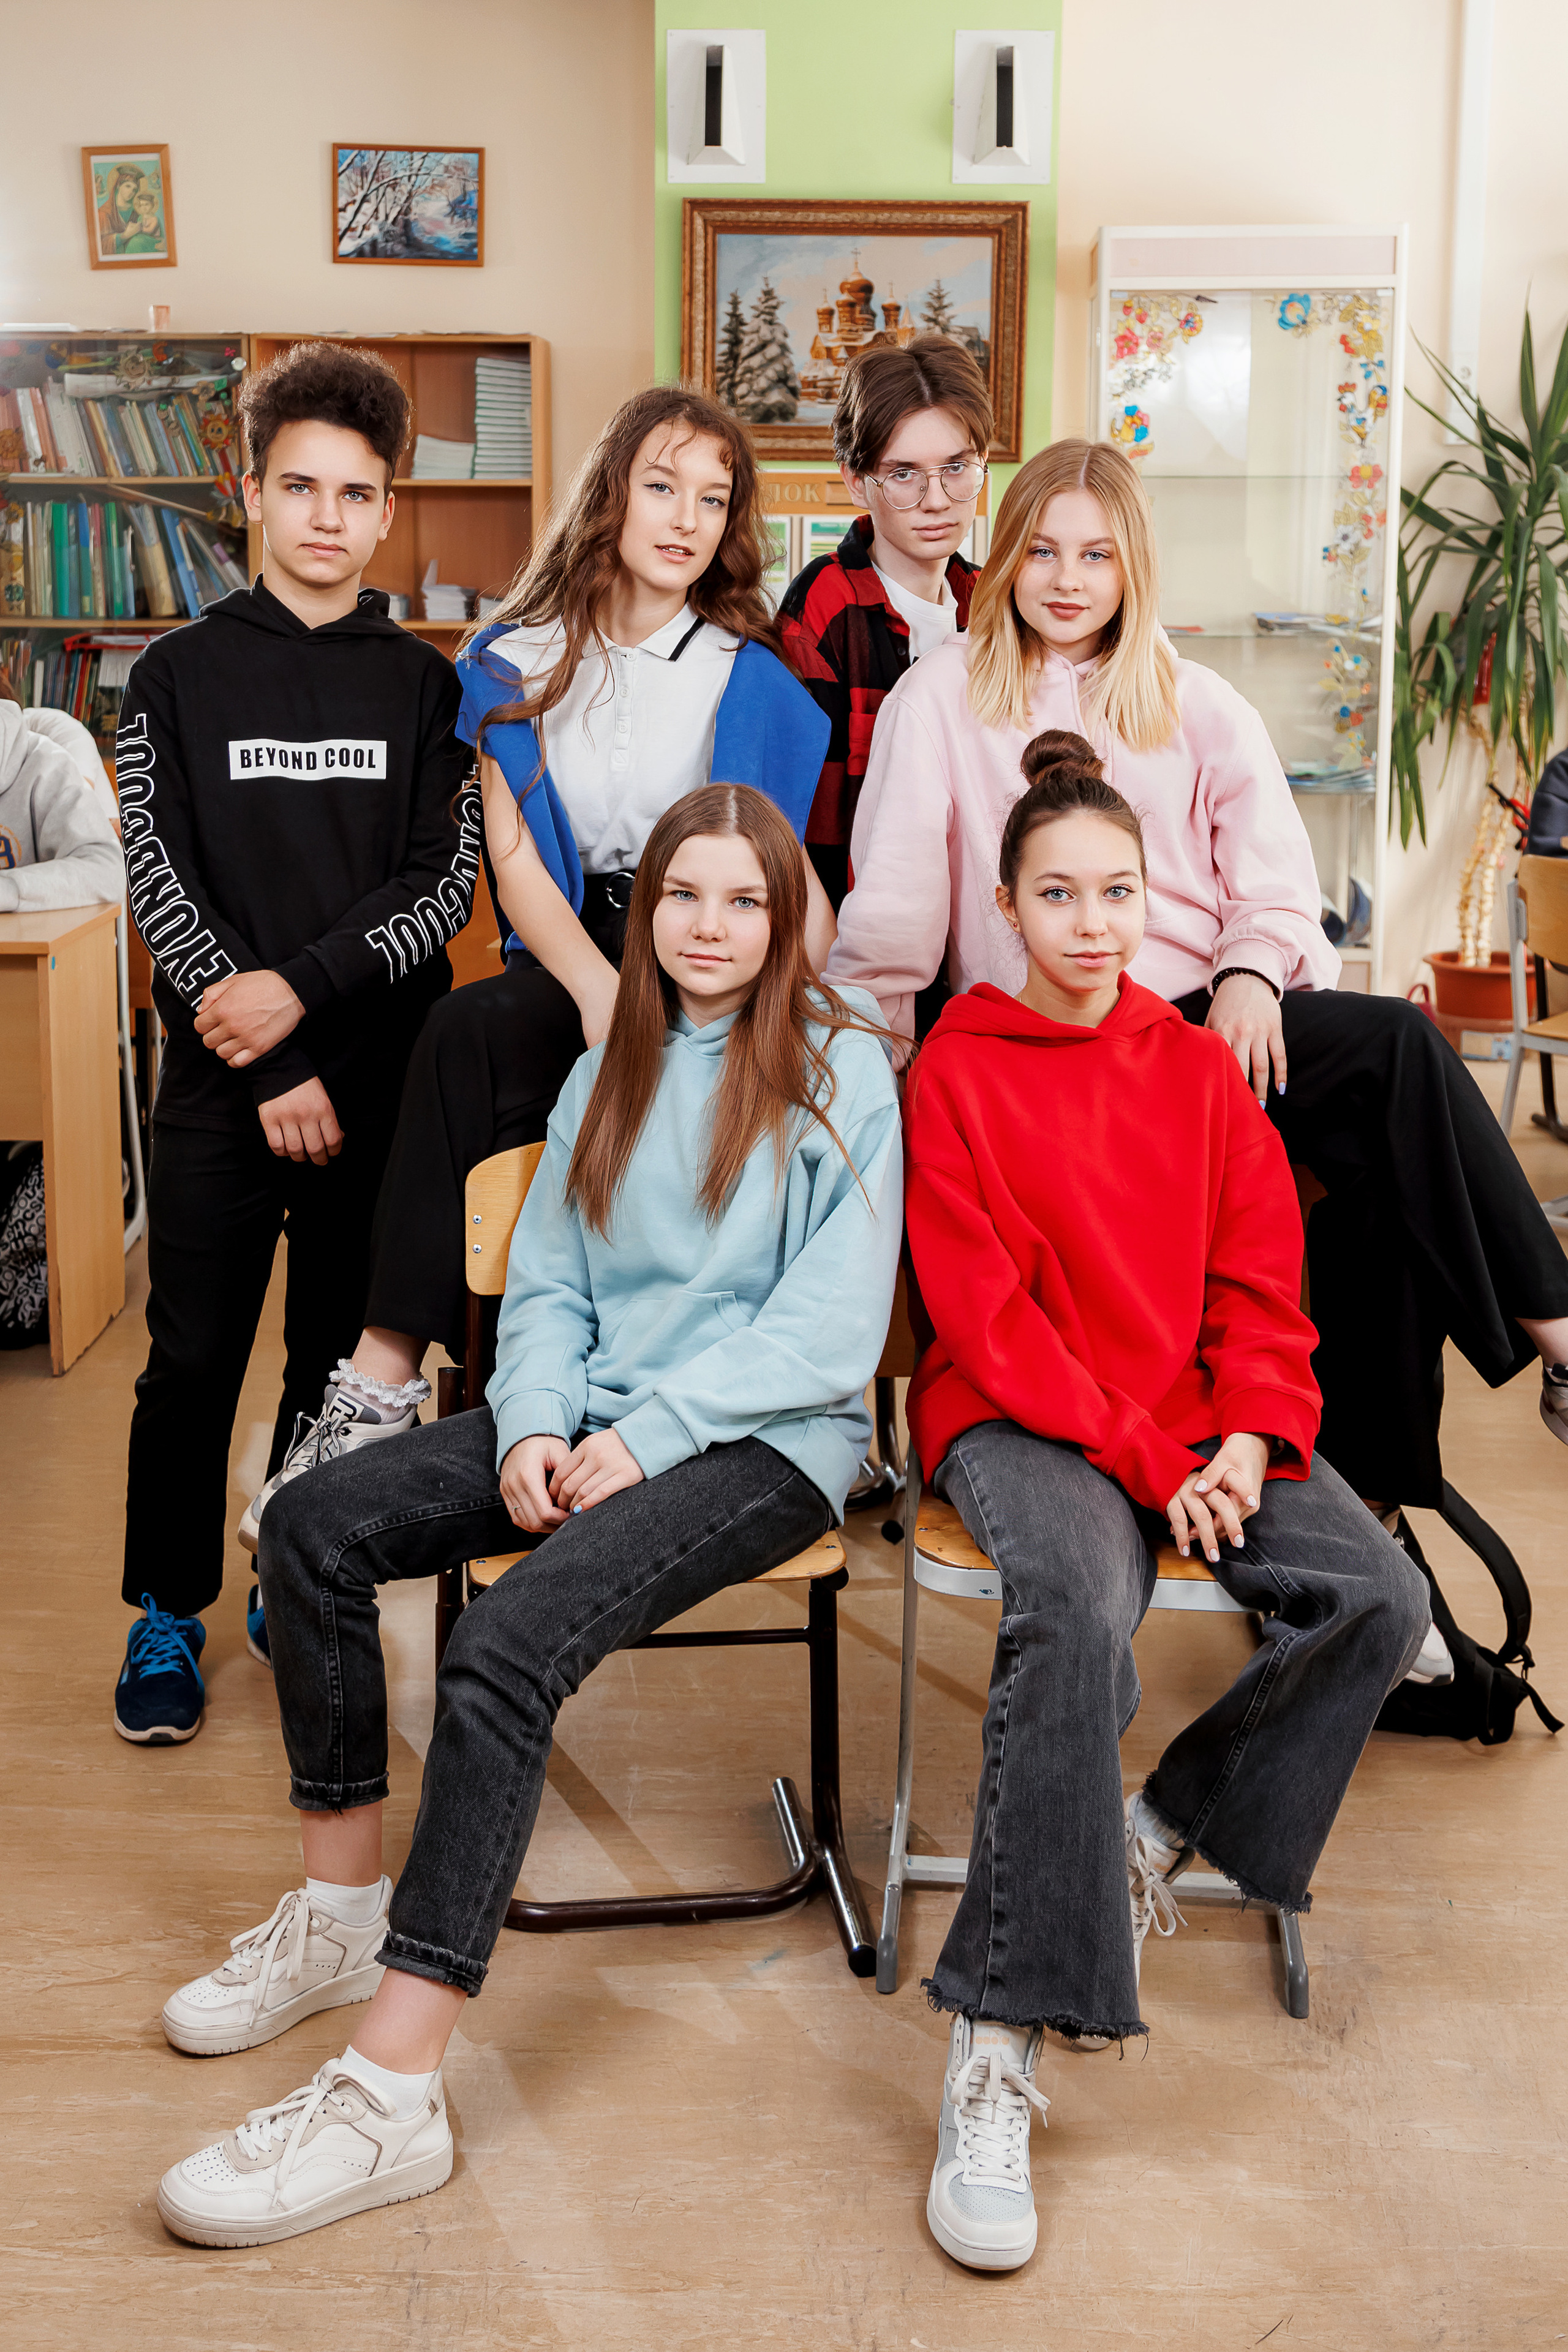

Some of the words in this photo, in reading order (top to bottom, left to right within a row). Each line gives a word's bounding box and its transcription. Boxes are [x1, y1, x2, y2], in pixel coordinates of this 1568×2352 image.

[767, 482, 821, 503] ЛОК
[240, 747, 317, 771] BEYOND
[325, 747, 376, 769] COOL
[126, 836, 238, 1008] EYOND
